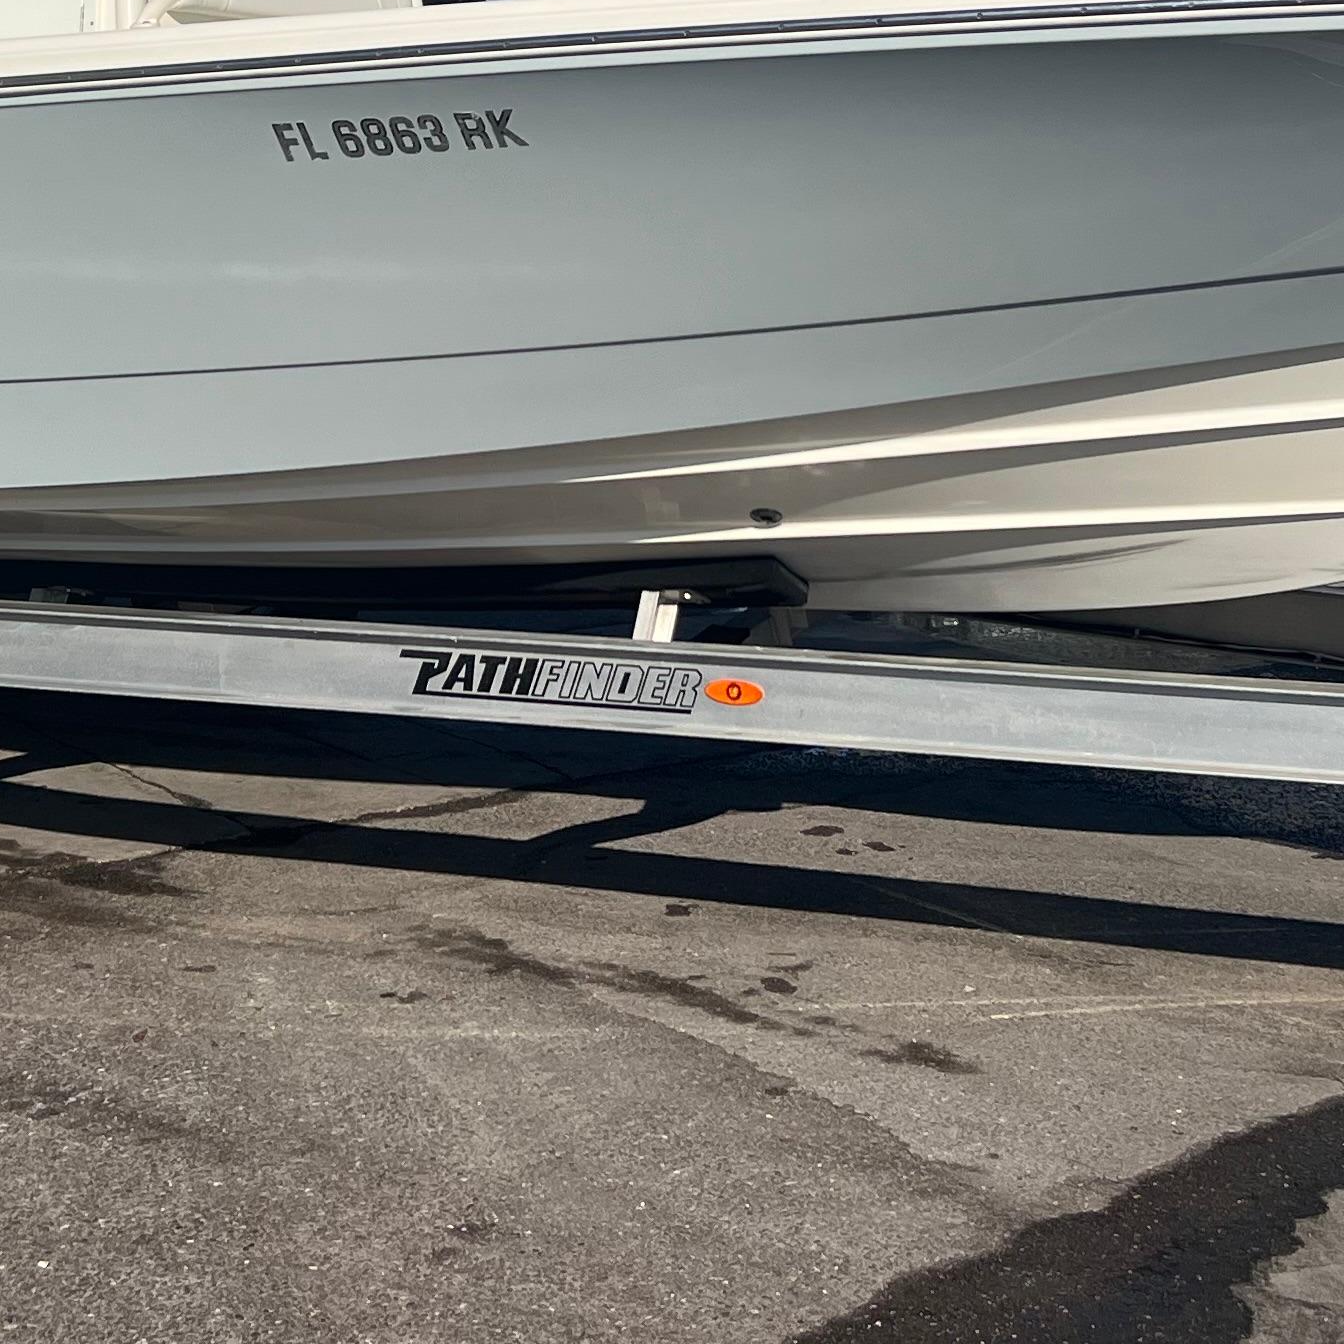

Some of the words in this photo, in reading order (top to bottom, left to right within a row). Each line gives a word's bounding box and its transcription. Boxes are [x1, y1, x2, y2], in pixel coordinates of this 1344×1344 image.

[271, 122, 330, 162] FL
[331, 114, 450, 158] 6863
[452, 109, 530, 151] RK
[400, 649, 703, 711] PATHFINDER
